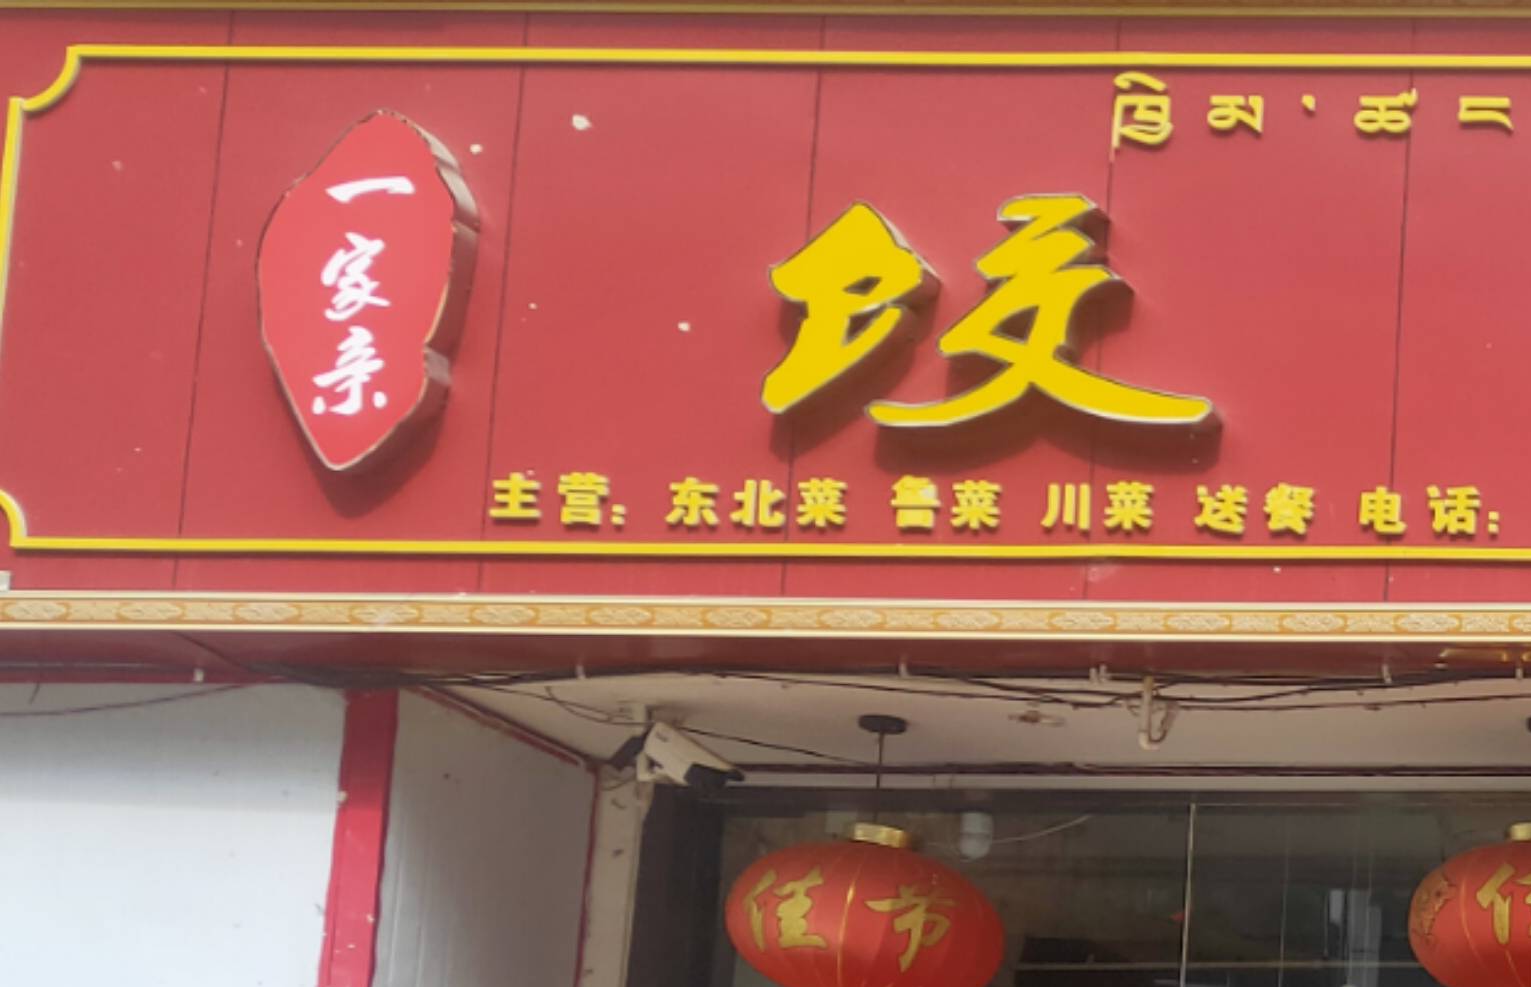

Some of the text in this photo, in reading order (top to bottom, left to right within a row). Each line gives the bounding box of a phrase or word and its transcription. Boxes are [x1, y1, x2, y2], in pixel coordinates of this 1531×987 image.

[312, 176, 415, 415] 一家亲
[668, 479, 842, 525] 东北菜
[895, 476, 997, 528] 鲁菜
[1045, 483, 1150, 528] 川菜
[1197, 486, 1311, 532] 送餐
[742, 867, 954, 972] 佳节
